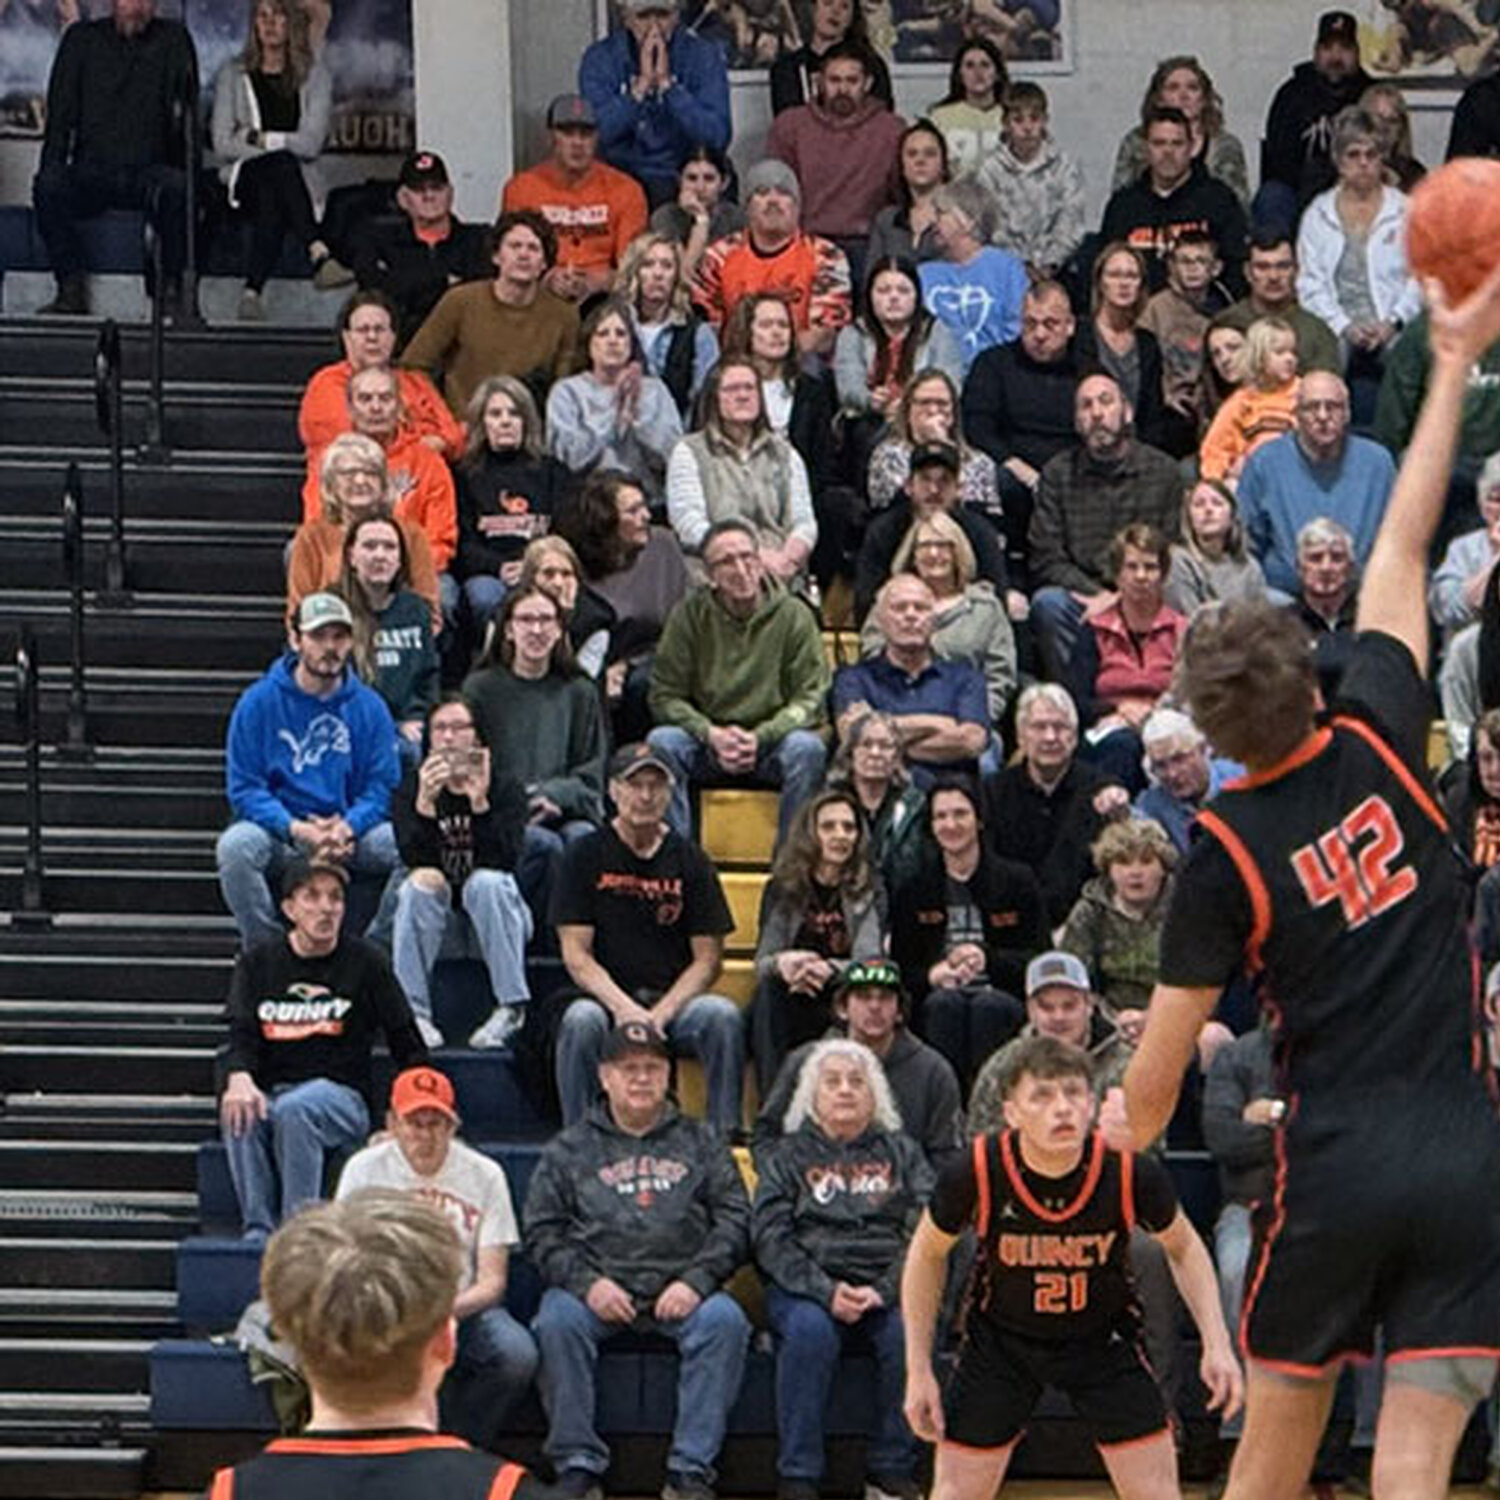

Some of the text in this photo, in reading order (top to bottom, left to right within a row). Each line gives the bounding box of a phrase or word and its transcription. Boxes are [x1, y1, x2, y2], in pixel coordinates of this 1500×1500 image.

[1290, 794, 1418, 930] 42
[413, 1072, 437, 1096] Q
[999, 1230, 1117, 1267] QUINCY
[1034, 1272, 1087, 1313] 21
